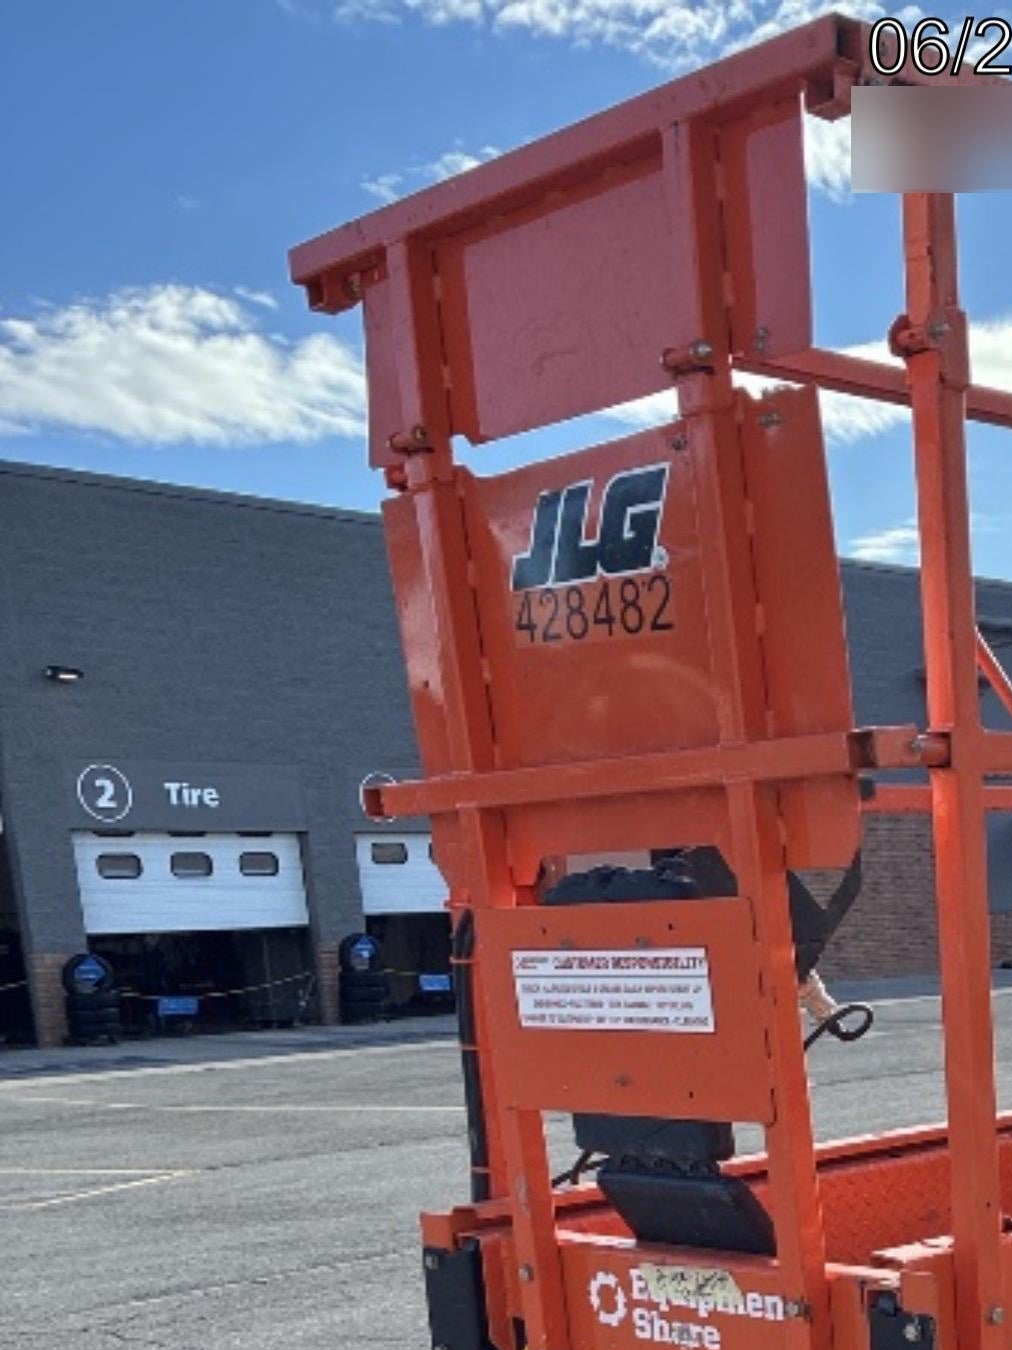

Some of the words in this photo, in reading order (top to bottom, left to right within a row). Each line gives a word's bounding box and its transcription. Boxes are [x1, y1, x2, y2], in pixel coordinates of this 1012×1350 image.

[516, 575, 675, 643] 428482
[95, 778, 118, 809] 2
[163, 782, 220, 808] Tire
